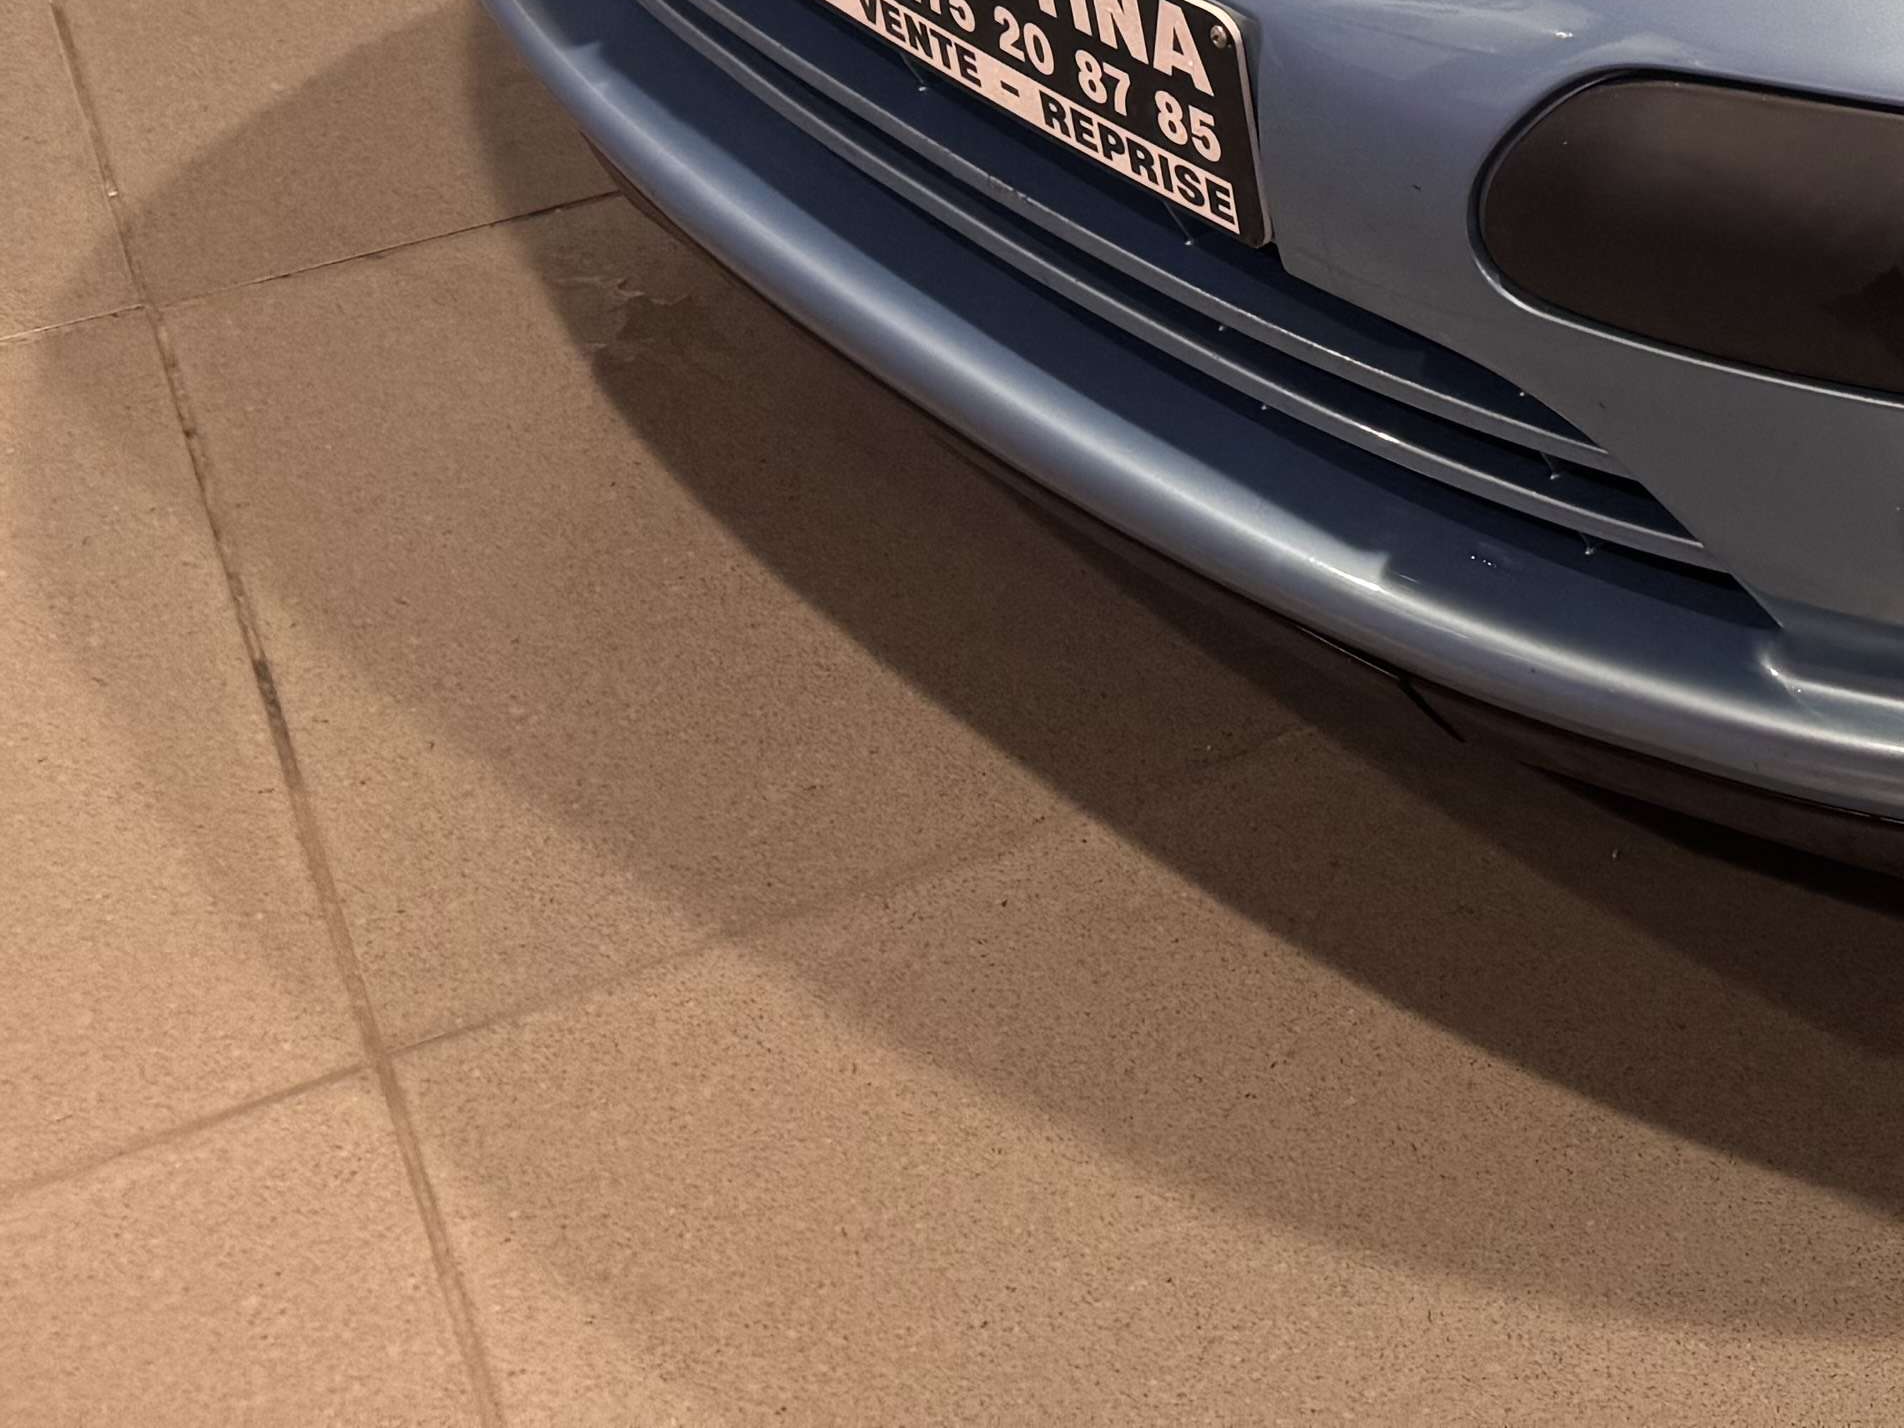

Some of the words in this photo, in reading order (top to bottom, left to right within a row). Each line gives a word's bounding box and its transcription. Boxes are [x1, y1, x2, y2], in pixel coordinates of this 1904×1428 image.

[994, 6, 1054, 76] 20
[1074, 49, 1131, 116] 87
[1155, 90, 1222, 162] 85
[1040, 90, 1234, 224] REPRISE
